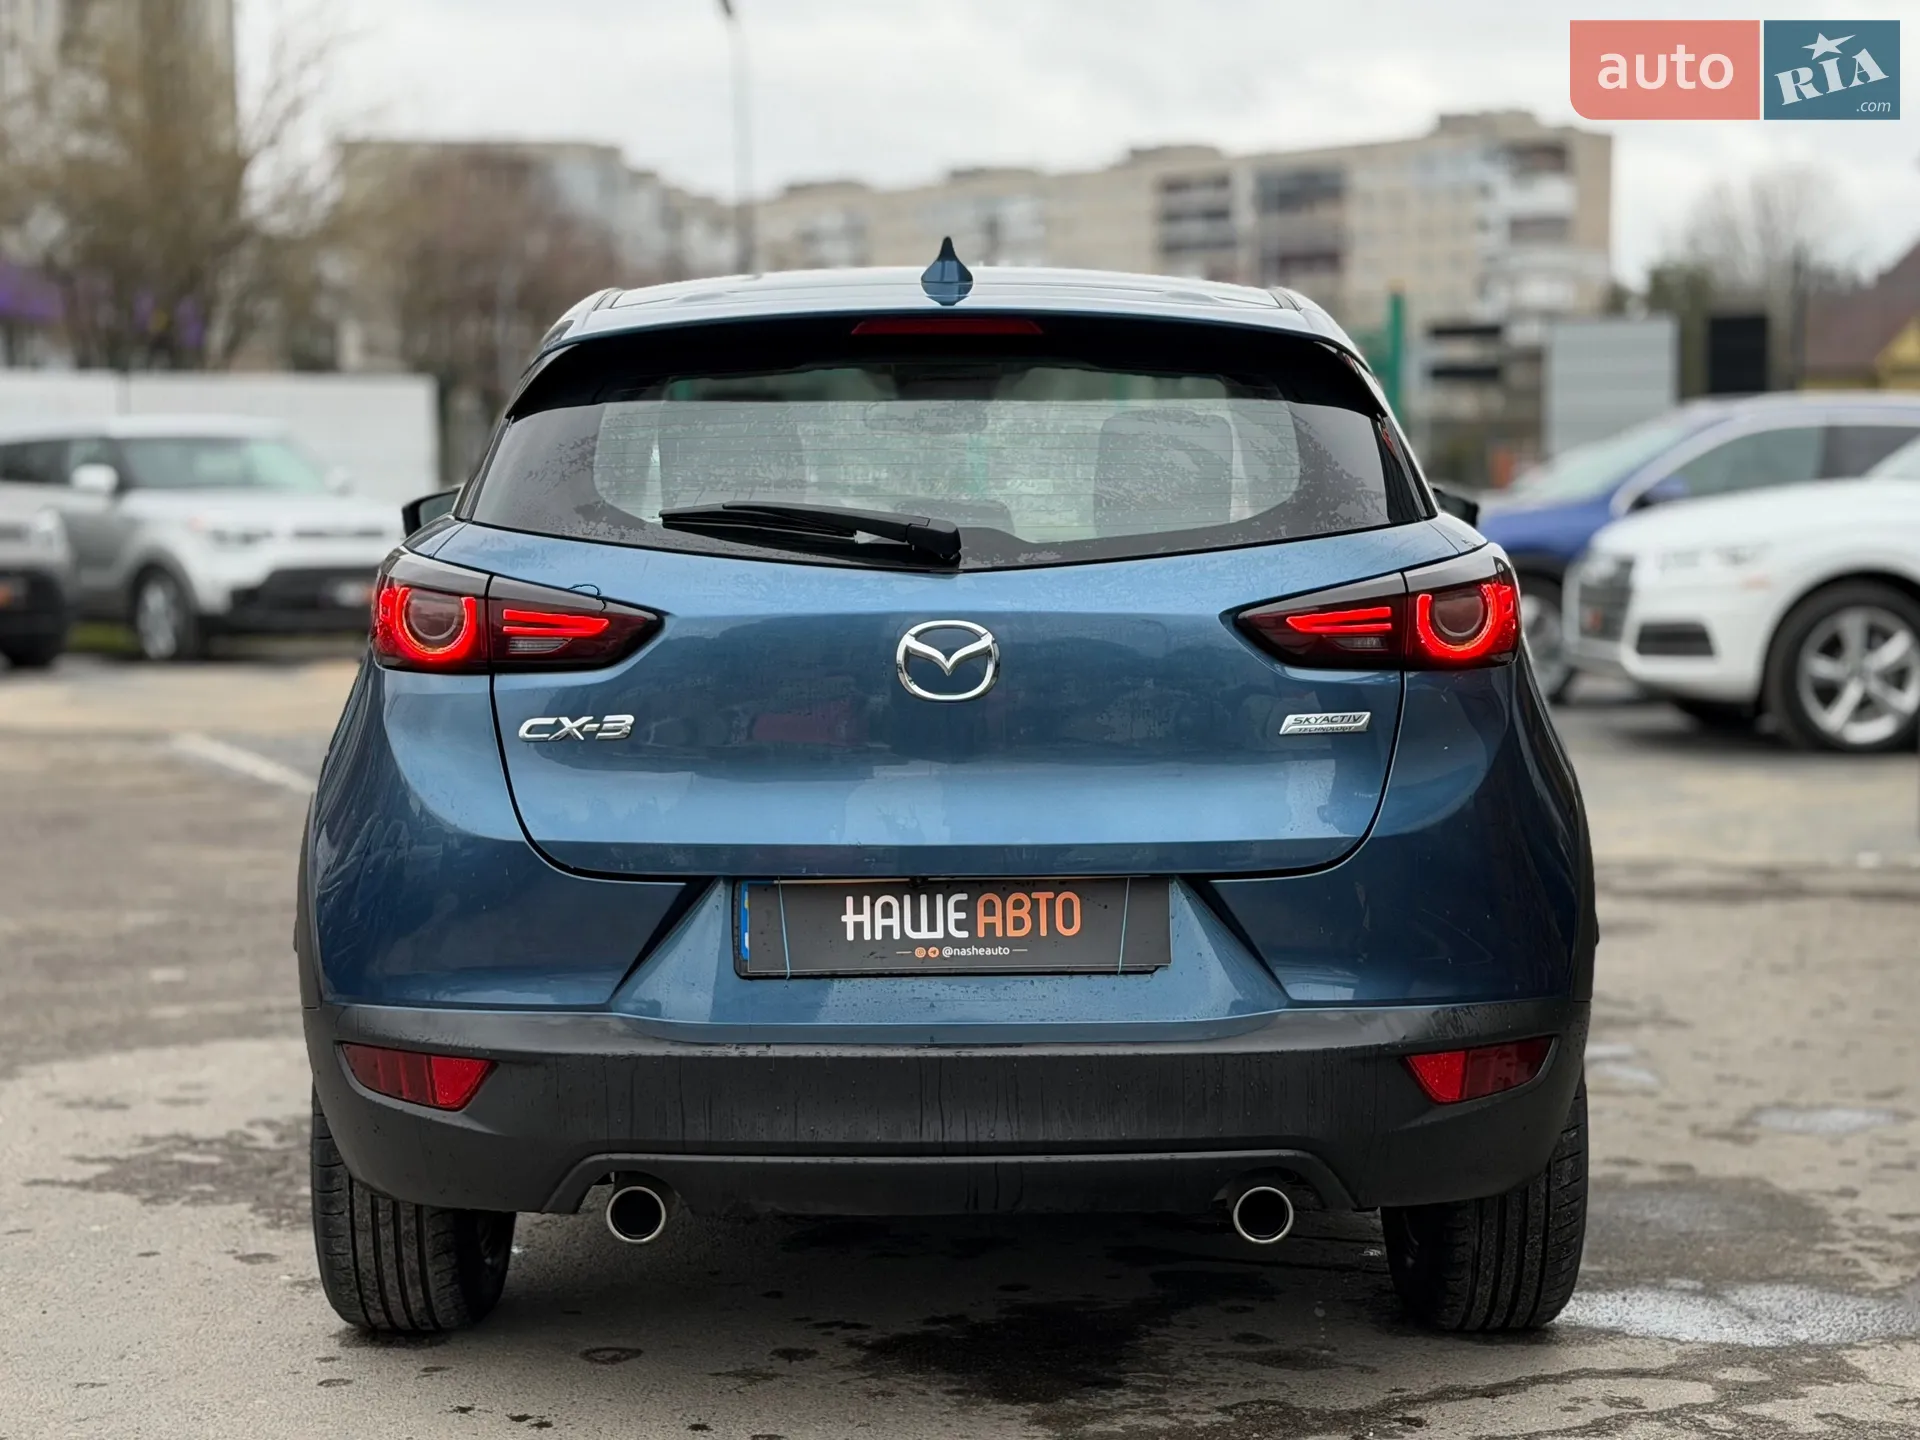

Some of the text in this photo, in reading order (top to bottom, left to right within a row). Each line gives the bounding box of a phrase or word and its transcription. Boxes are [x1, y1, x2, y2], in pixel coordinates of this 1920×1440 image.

[518, 714, 635, 741] CX-3
[1292, 714, 1363, 725] SKYACTIV
[841, 891, 1083, 941] НАШЕ АВТО
[942, 945, 1010, 958] @nasheauto
